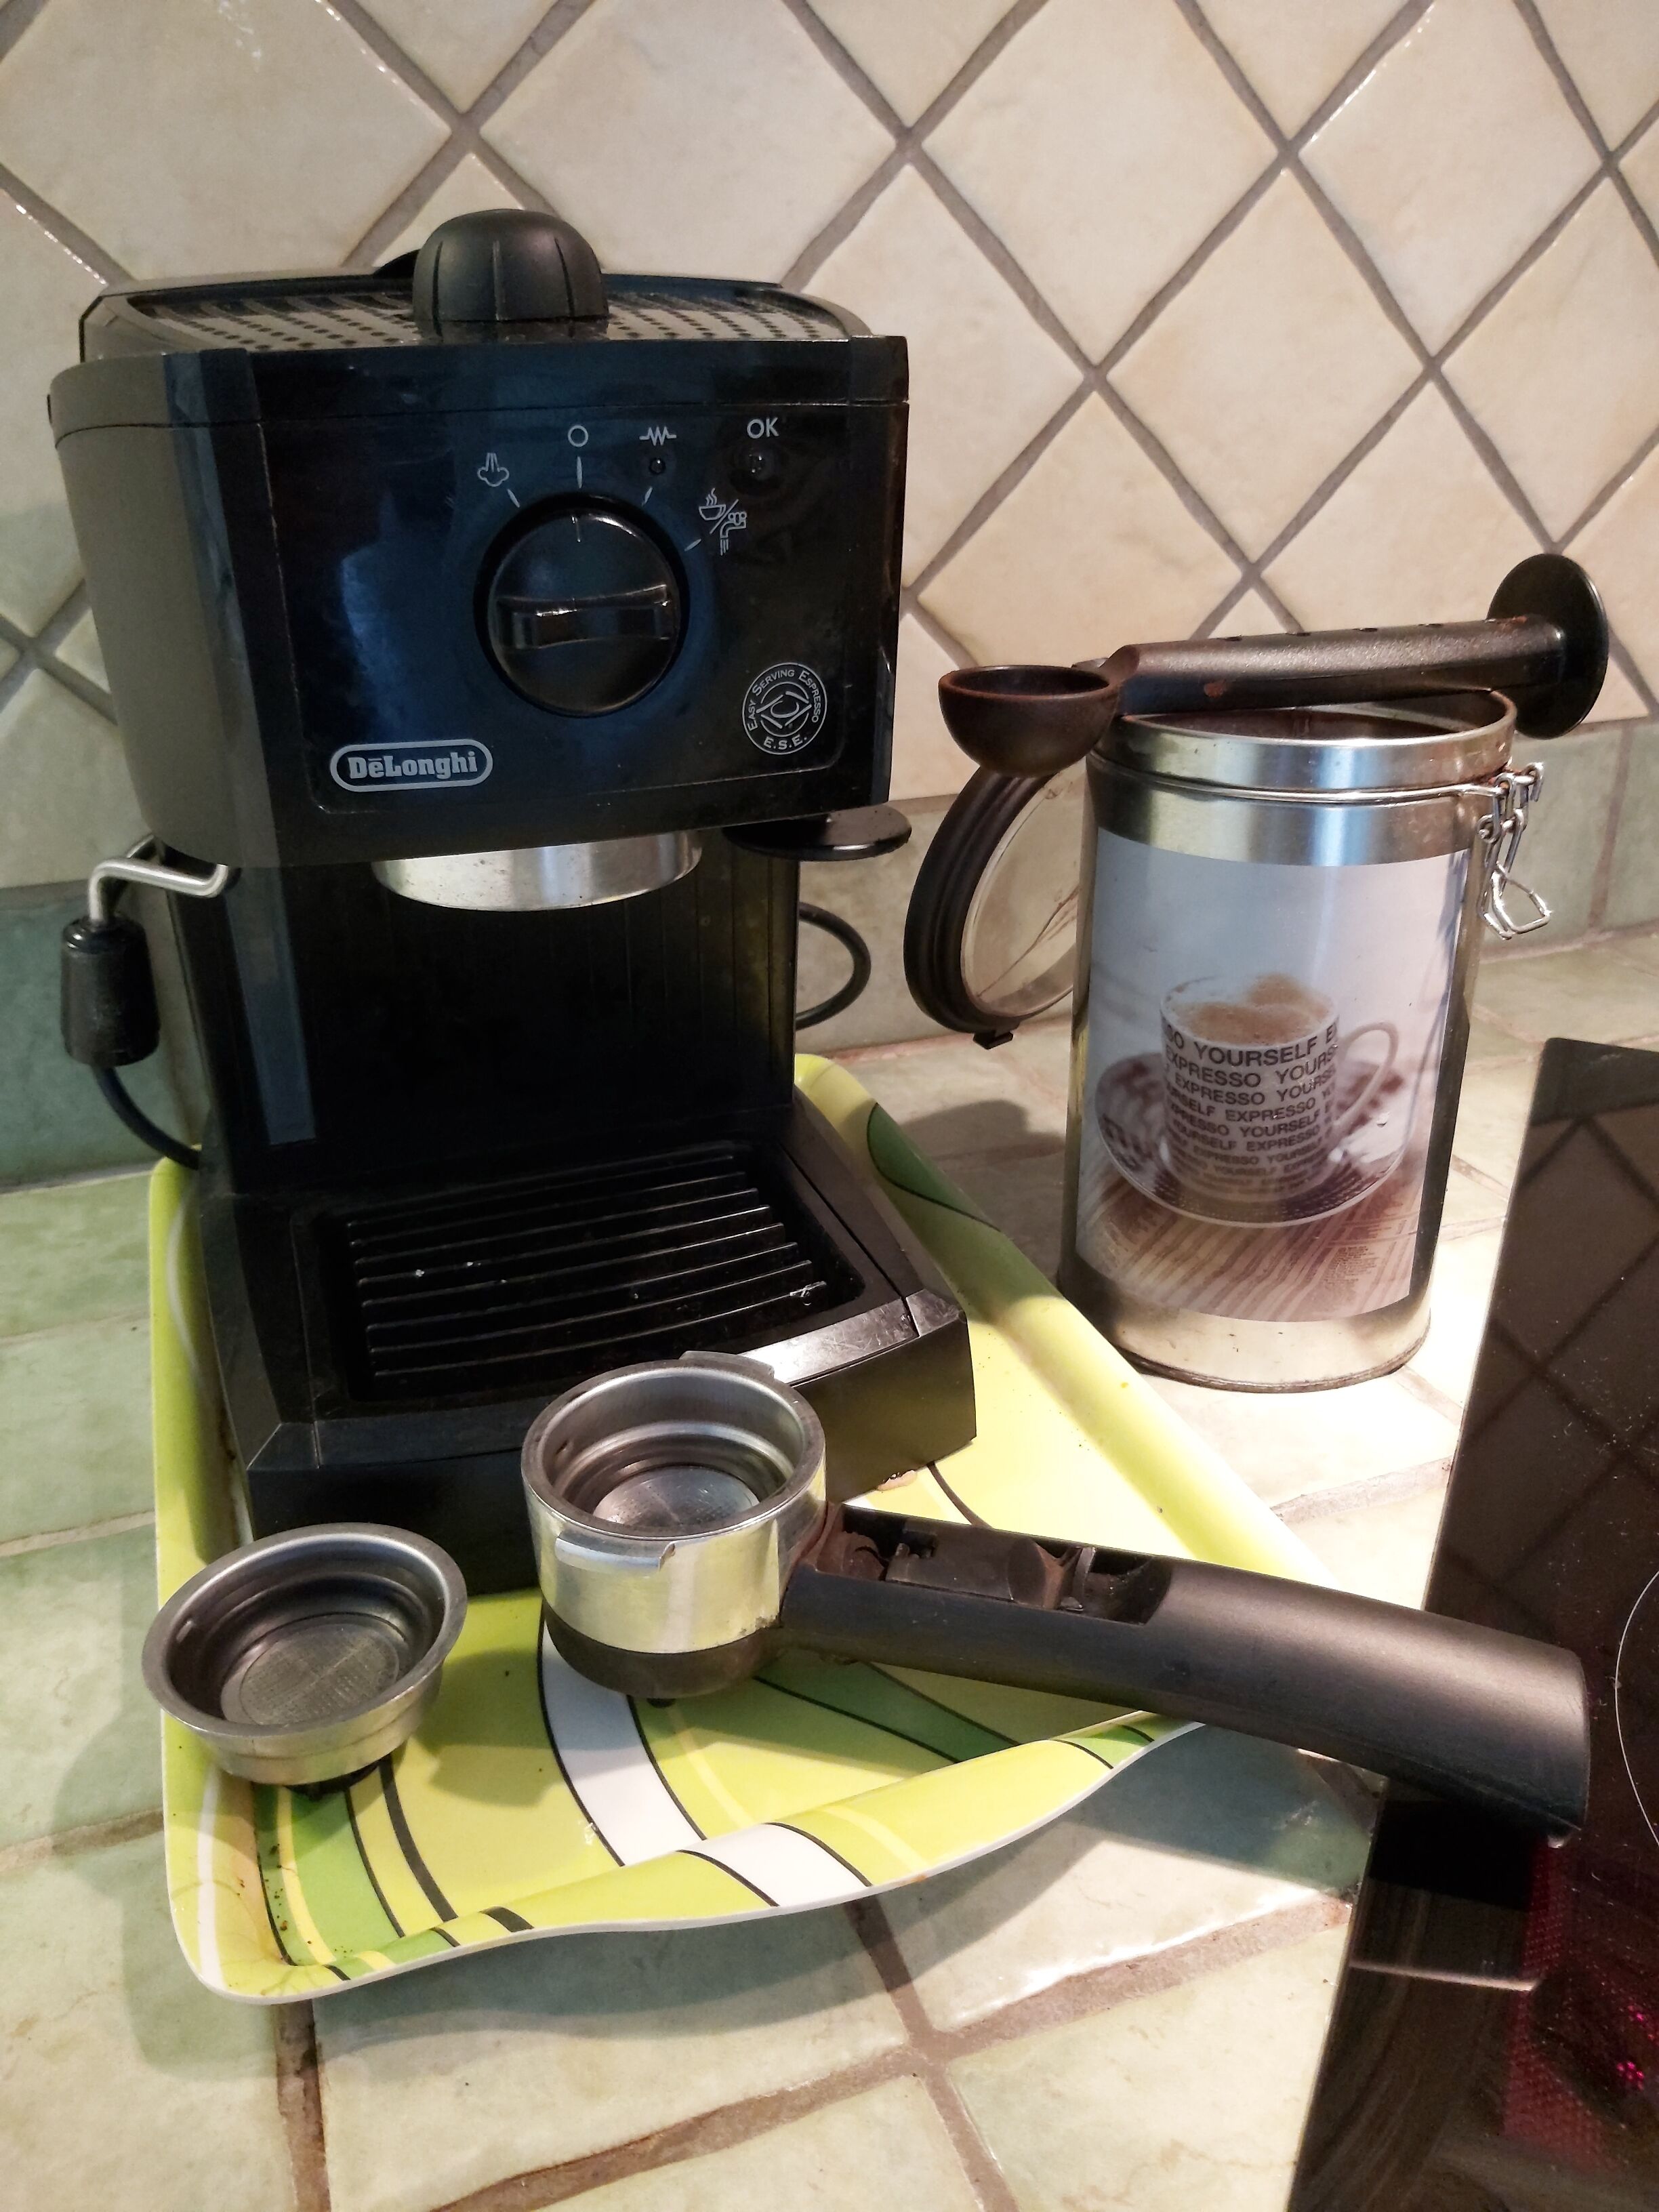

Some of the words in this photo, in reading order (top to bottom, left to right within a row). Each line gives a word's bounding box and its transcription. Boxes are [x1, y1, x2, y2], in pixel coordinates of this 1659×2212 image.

[747, 417, 779, 439] OK
[752, 669, 795, 697] SERVING
[798, 670, 821, 723] ESPRESSO
[747, 699, 758, 732] EASY
[763, 733, 807, 750] E.S.E.
[1166, 1044, 1261, 1088] EXPRESSO
[1193, 1036, 1318, 1067] YOURSELF
[1175, 1072, 1265, 1106] EXPRESSO
[1225, 1097, 1316, 1122] EXPRESSO
[1240, 1109, 1321, 1138] YOURSELF
[1246, 1124, 1321, 1151] EXPRESSO
